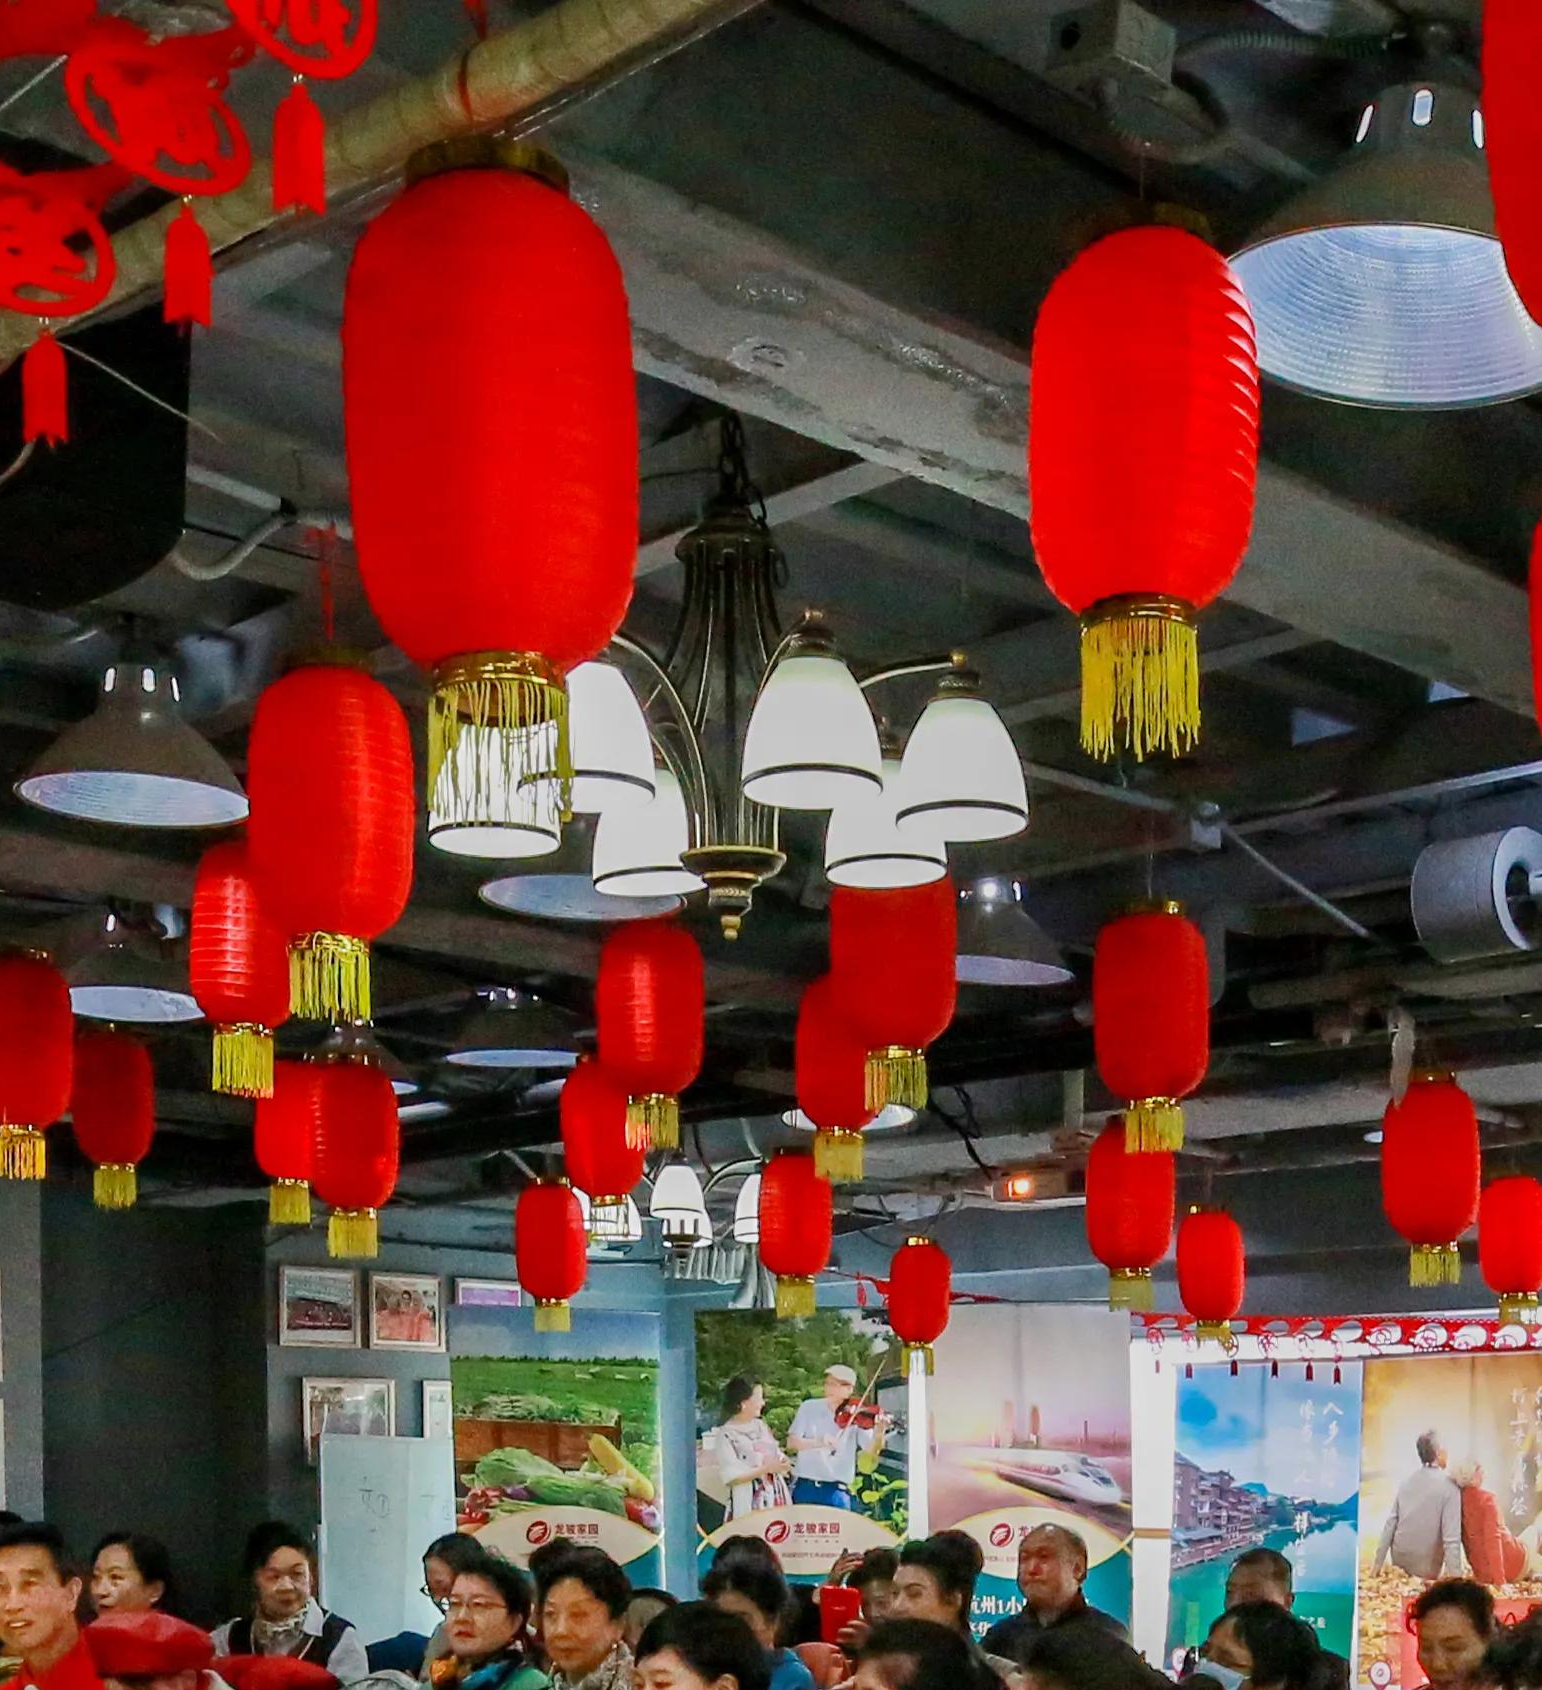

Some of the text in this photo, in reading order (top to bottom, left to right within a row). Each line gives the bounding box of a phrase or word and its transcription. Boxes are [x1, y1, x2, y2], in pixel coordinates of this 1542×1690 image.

[554, 1523, 599, 1535] 龙骏家园
[794, 1522, 841, 1534] 龙骏家园
[970, 1595, 1027, 1615] 杭州1小
